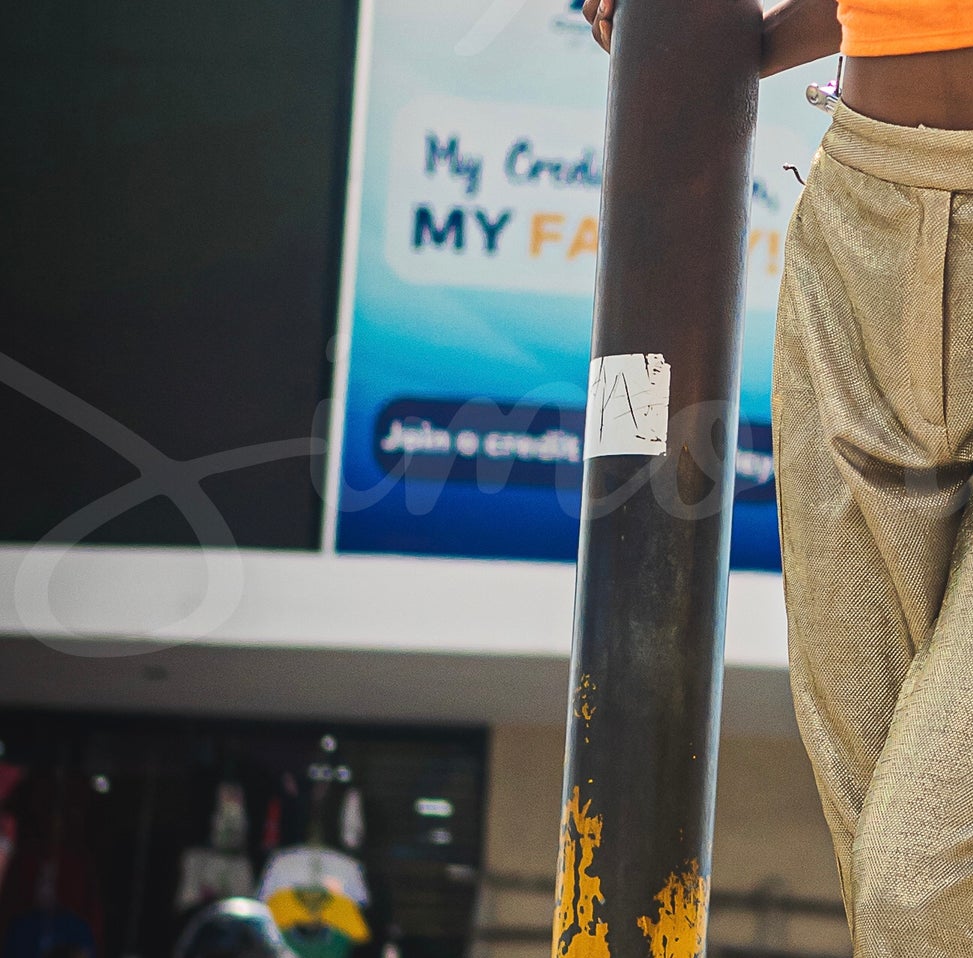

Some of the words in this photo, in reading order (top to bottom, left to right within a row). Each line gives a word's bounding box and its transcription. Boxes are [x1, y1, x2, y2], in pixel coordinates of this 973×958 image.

[425, 131, 481, 195] My
[411, 205, 513, 255] MY
[380, 419, 450, 452] Join
[484, 430, 580, 463] credit
